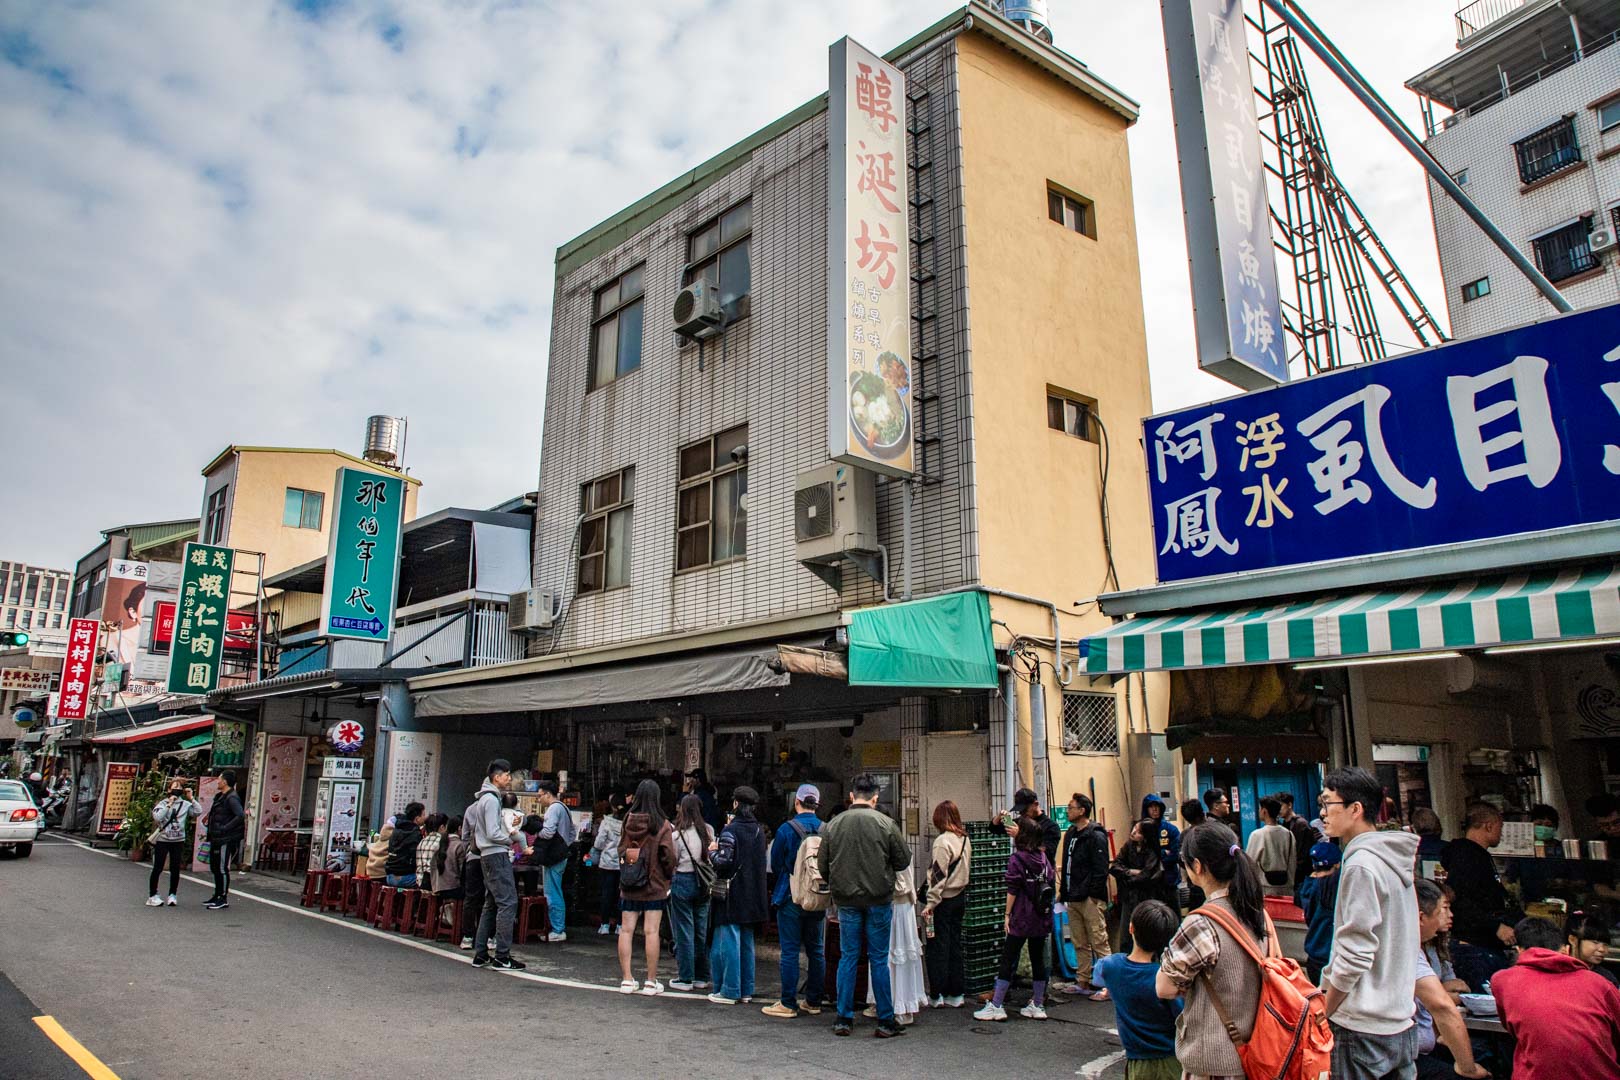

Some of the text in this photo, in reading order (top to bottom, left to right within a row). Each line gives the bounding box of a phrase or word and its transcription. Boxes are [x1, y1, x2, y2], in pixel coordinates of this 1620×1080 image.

[851, 275, 867, 368] 鍋燒系列
[867, 284, 882, 351] 古早味
[1155, 412, 1240, 558] 阿鳳
[1235, 412, 1294, 529] 浮水
[345, 480, 387, 614] 那個年代
[63, 628, 93, 710] 阿村牛肉湯
[187, 573, 224, 688] 蝦仁肉圓
